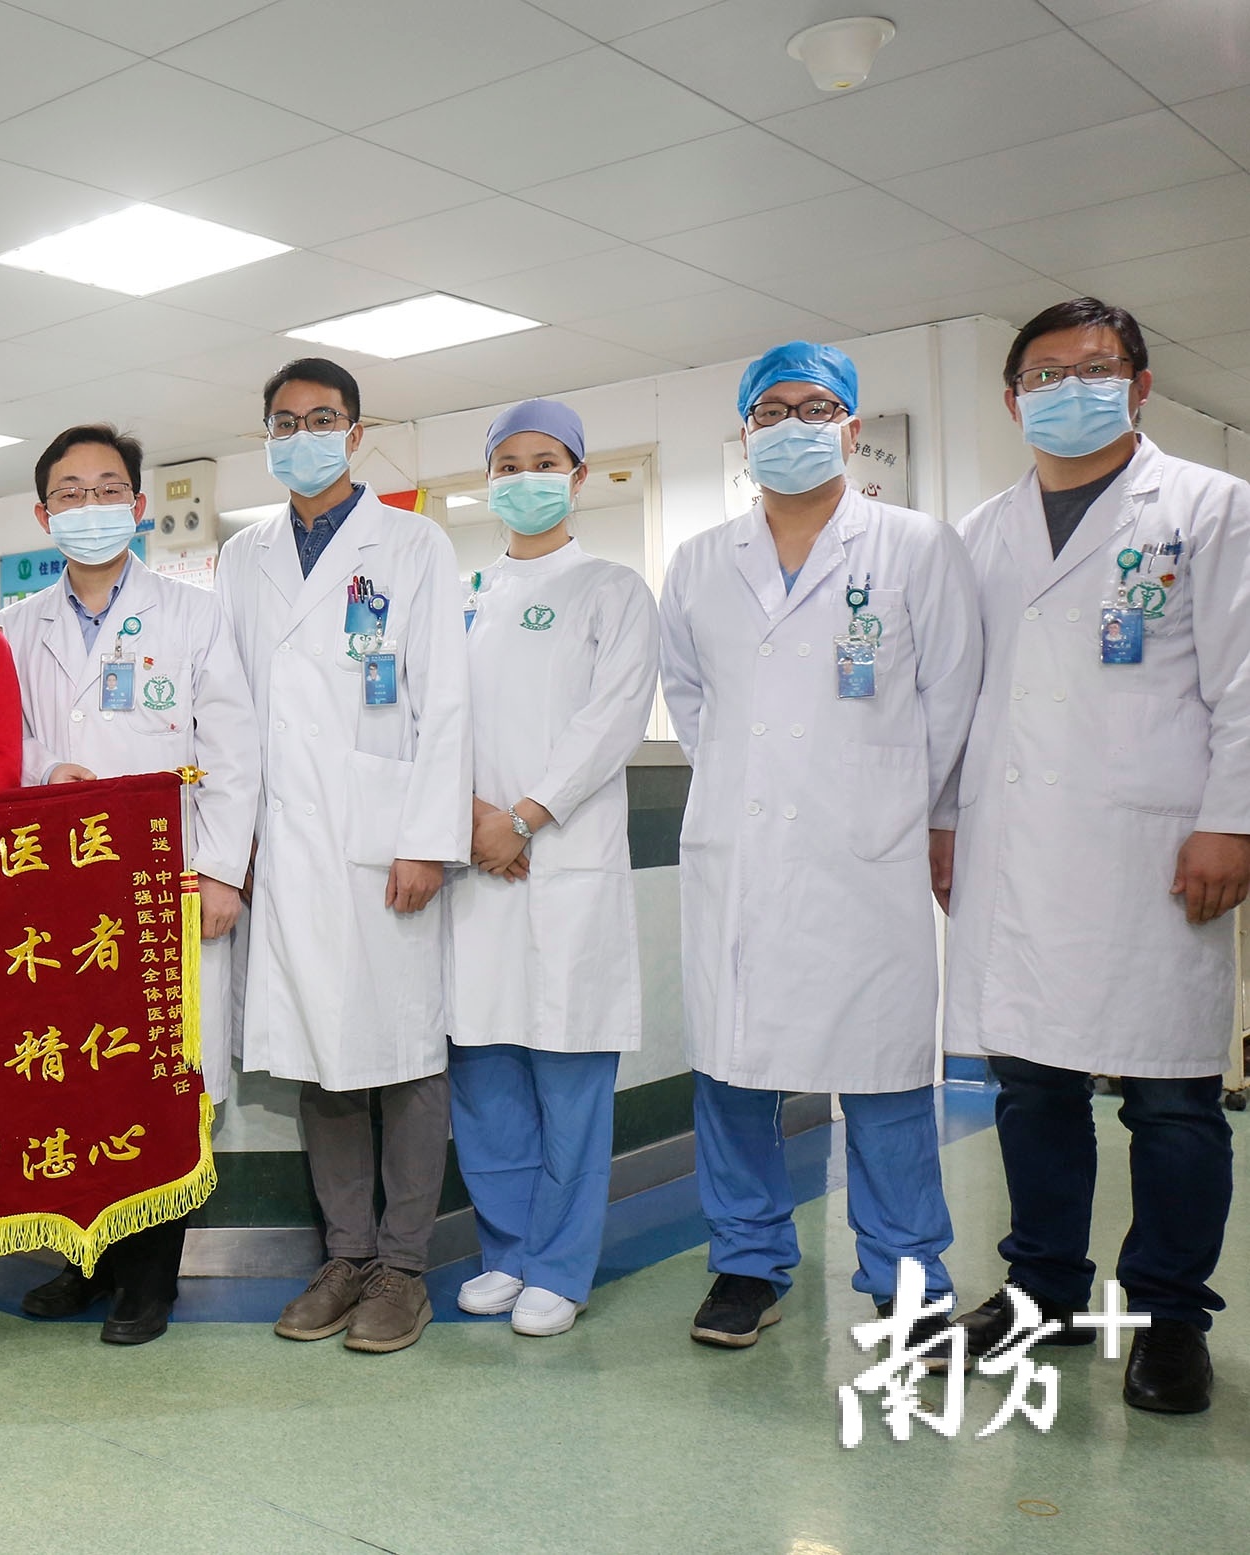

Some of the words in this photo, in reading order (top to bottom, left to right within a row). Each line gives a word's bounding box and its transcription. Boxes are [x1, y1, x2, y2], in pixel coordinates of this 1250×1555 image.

[69, 812, 146, 1164] 医者仁心
[132, 870, 169, 1080] 孙强医生及全体医护人员
